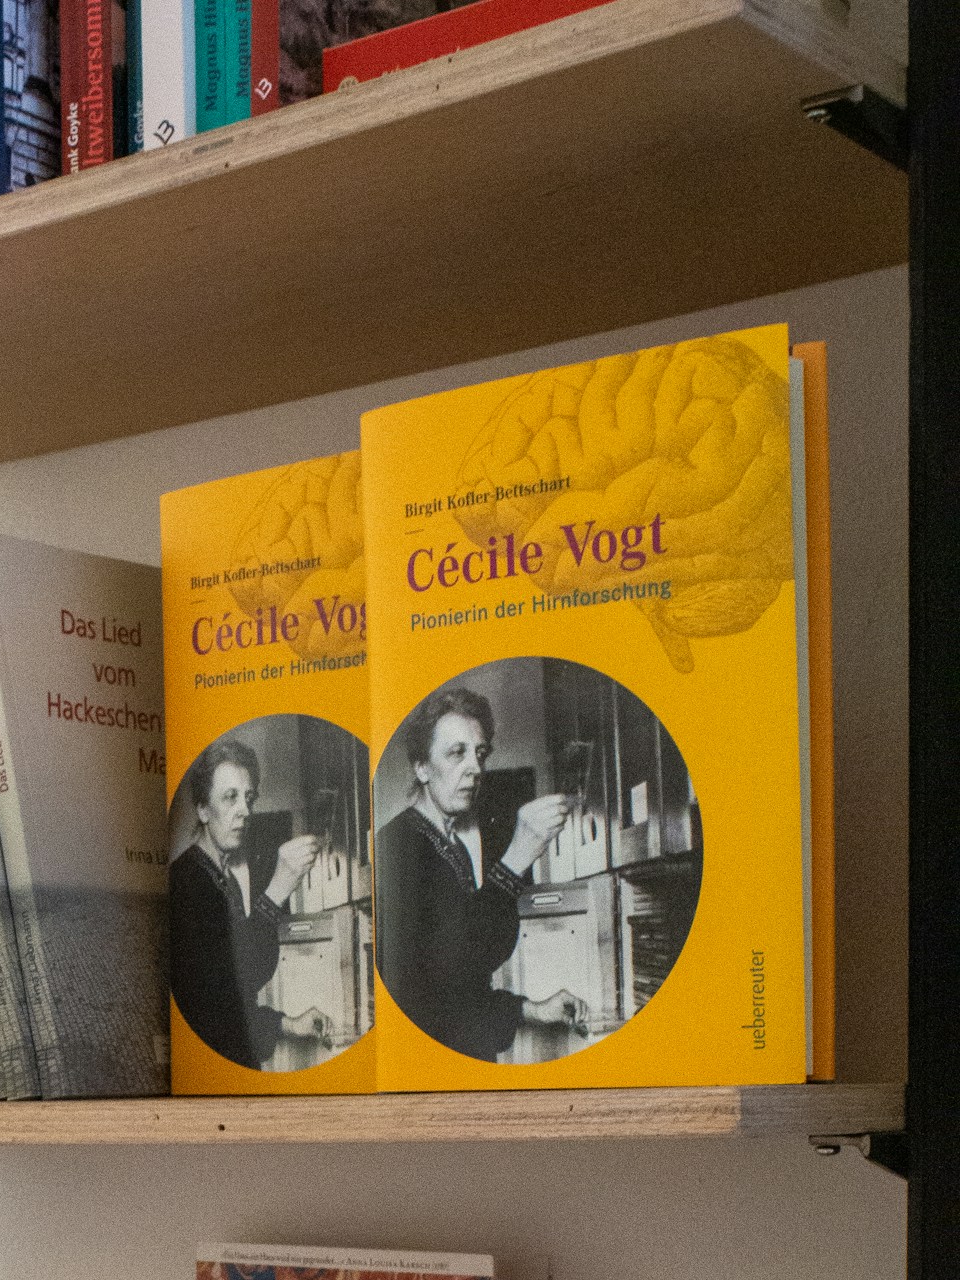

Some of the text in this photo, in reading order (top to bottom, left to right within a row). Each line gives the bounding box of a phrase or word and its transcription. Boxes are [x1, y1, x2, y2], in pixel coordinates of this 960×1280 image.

[203, 33, 220, 113] Magnus
[67, 102, 80, 146] Goyke
[404, 474, 572, 519] Birgit Kofler-Bettschart
[190, 555, 322, 590] Birgit Kofler-Bettschart
[406, 512, 669, 594] Cécile Vogt
[410, 578, 672, 632] Pionierin der Hirnforschung
[60, 608, 142, 648] Das Lied
[191, 604, 301, 657] Cécile
[92, 661, 137, 687] vom
[194, 663, 285, 690] Pionierin der
[46, 691, 164, 733] Hackeschen
[742, 949, 767, 1052] ueberreuter
